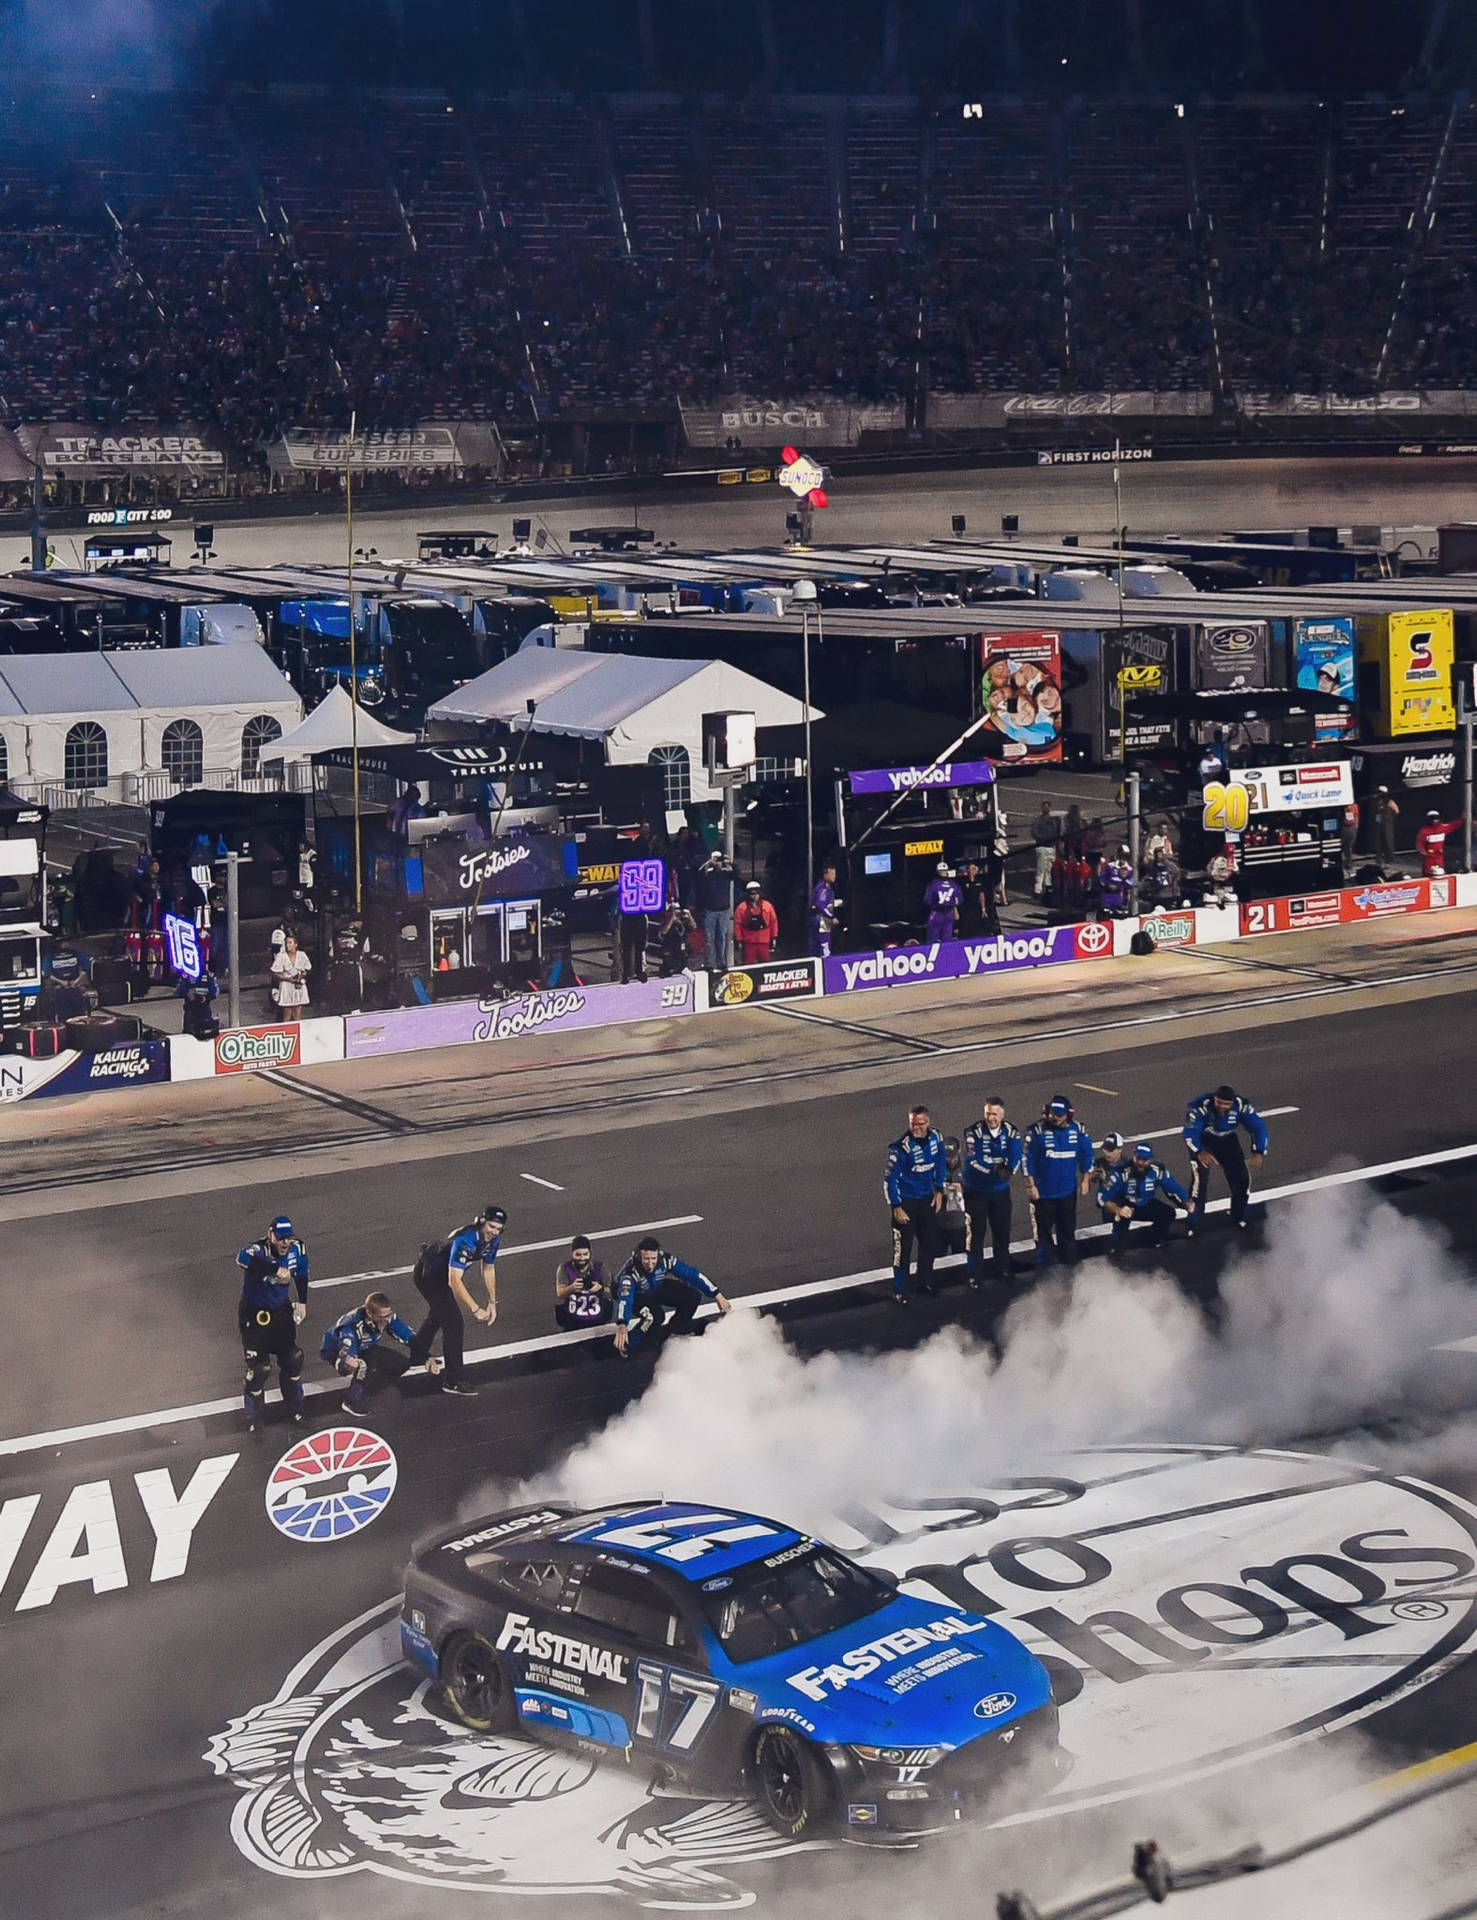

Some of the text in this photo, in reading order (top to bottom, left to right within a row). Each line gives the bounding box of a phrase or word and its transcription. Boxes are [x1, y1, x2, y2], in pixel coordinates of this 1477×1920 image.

[722, 411, 825, 428] BUSCH
[312, 448, 435, 461] CUP SERIES
[1053, 451, 1090, 463] FIRST
[780, 469, 822, 486] SUNOCO
[87, 509, 115, 524] FOOD
[127, 509, 150, 521] CITY
[451, 761, 545, 777] TRACKHOUSE
[1401, 753, 1456, 777] Hendrick
[1203, 780, 1250, 832] 20
[620, 859, 664, 913] 99
[1144, 919, 1191, 939] O'Reilly
[1248, 903, 1276, 932] 21
[164, 913, 201, 979] 16
[964, 928, 1057, 974] yahoo!
[763, 968, 809, 984] TRACKER
[841, 943, 940, 990] yahoo!
[660, 983, 688, 1008] 99
[474, 989, 585, 1041] Tootsies
[93, 1047, 140, 1065] KAULIG
[220, 1034, 293, 1062] O'Reilly
[89, 1060, 139, 1078] RACING
[496, 1611, 628, 1685] FASTENAL
[785, 1614, 988, 1702] FASTENAL
[884, 1665, 921, 1687] WHERE
[892, 1673, 927, 1695] MEETS
[636, 1660, 723, 1752] 17
[979, 1696, 1011, 1716] Ford
[762, 1707, 816, 1733] GOODYEAR
[897, 1766, 921, 1783] 17
